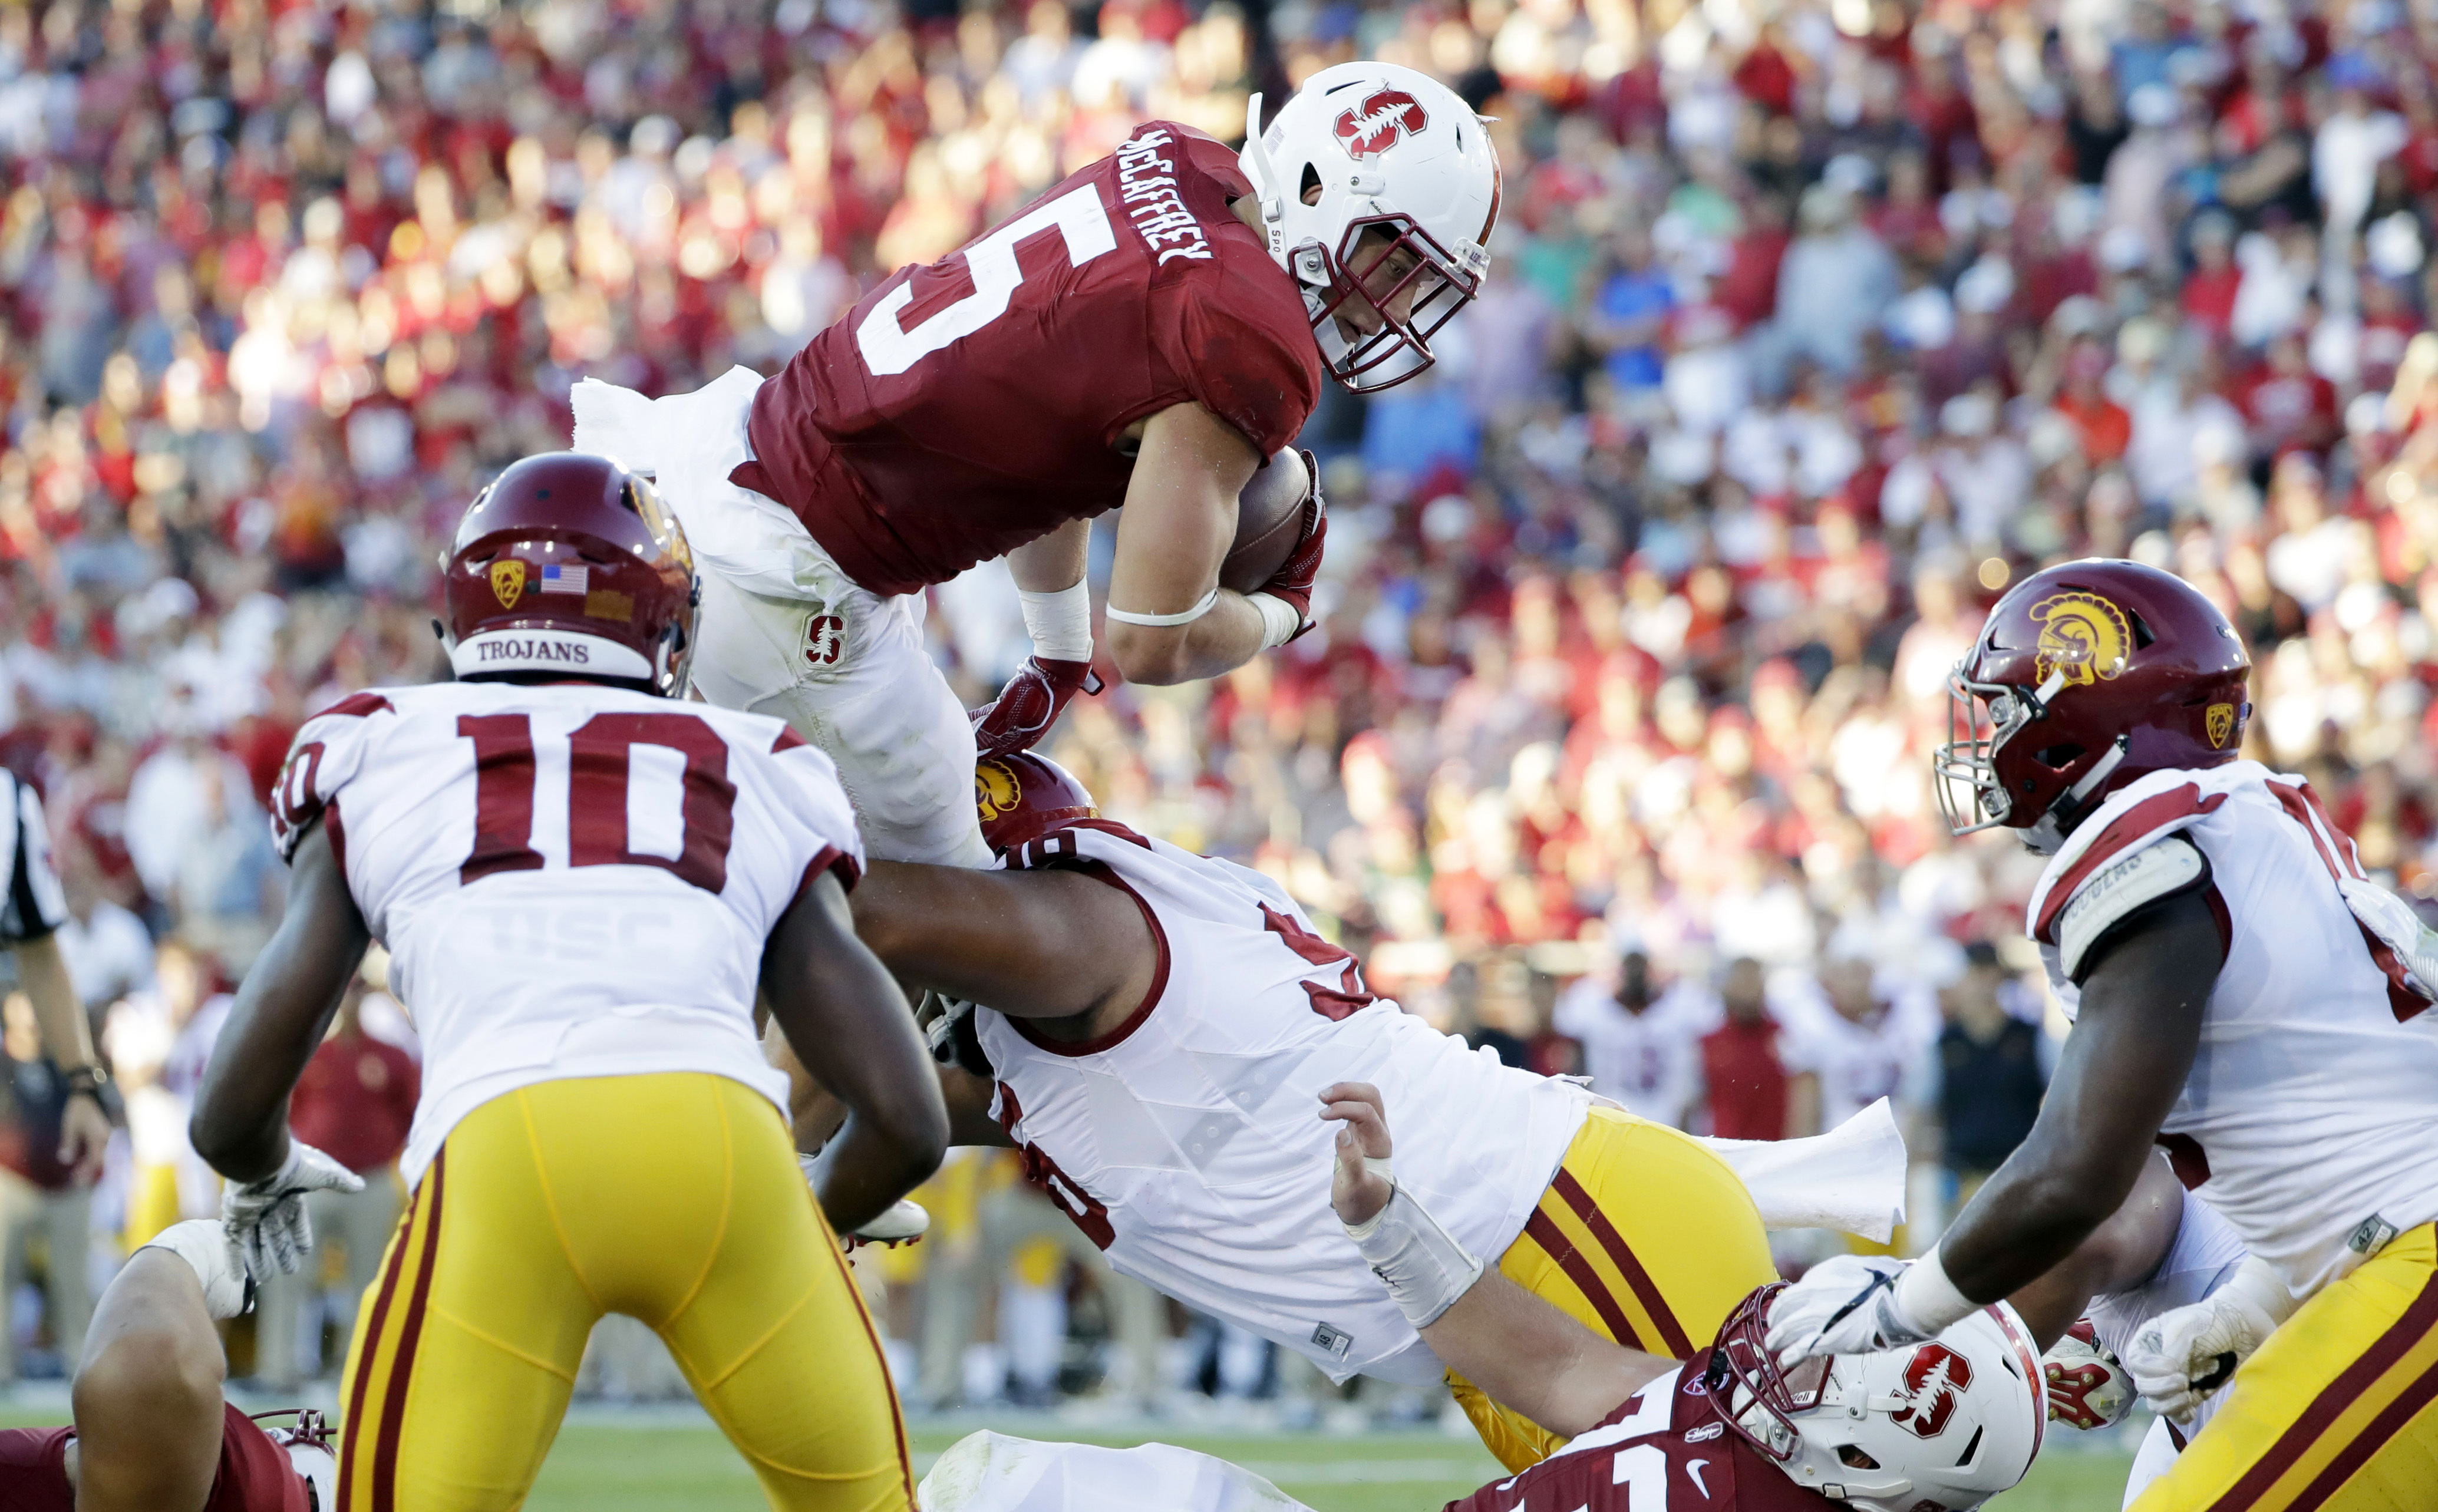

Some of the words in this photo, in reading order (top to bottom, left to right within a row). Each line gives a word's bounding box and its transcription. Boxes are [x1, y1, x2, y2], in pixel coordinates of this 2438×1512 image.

[856, 181, 1118, 377] 5
[477, 639, 589, 663] TROJANS
[456, 712, 738, 896] 10
[2358, 1227, 2373, 1246] 42
[1318, 1334, 1331, 1345] 48
